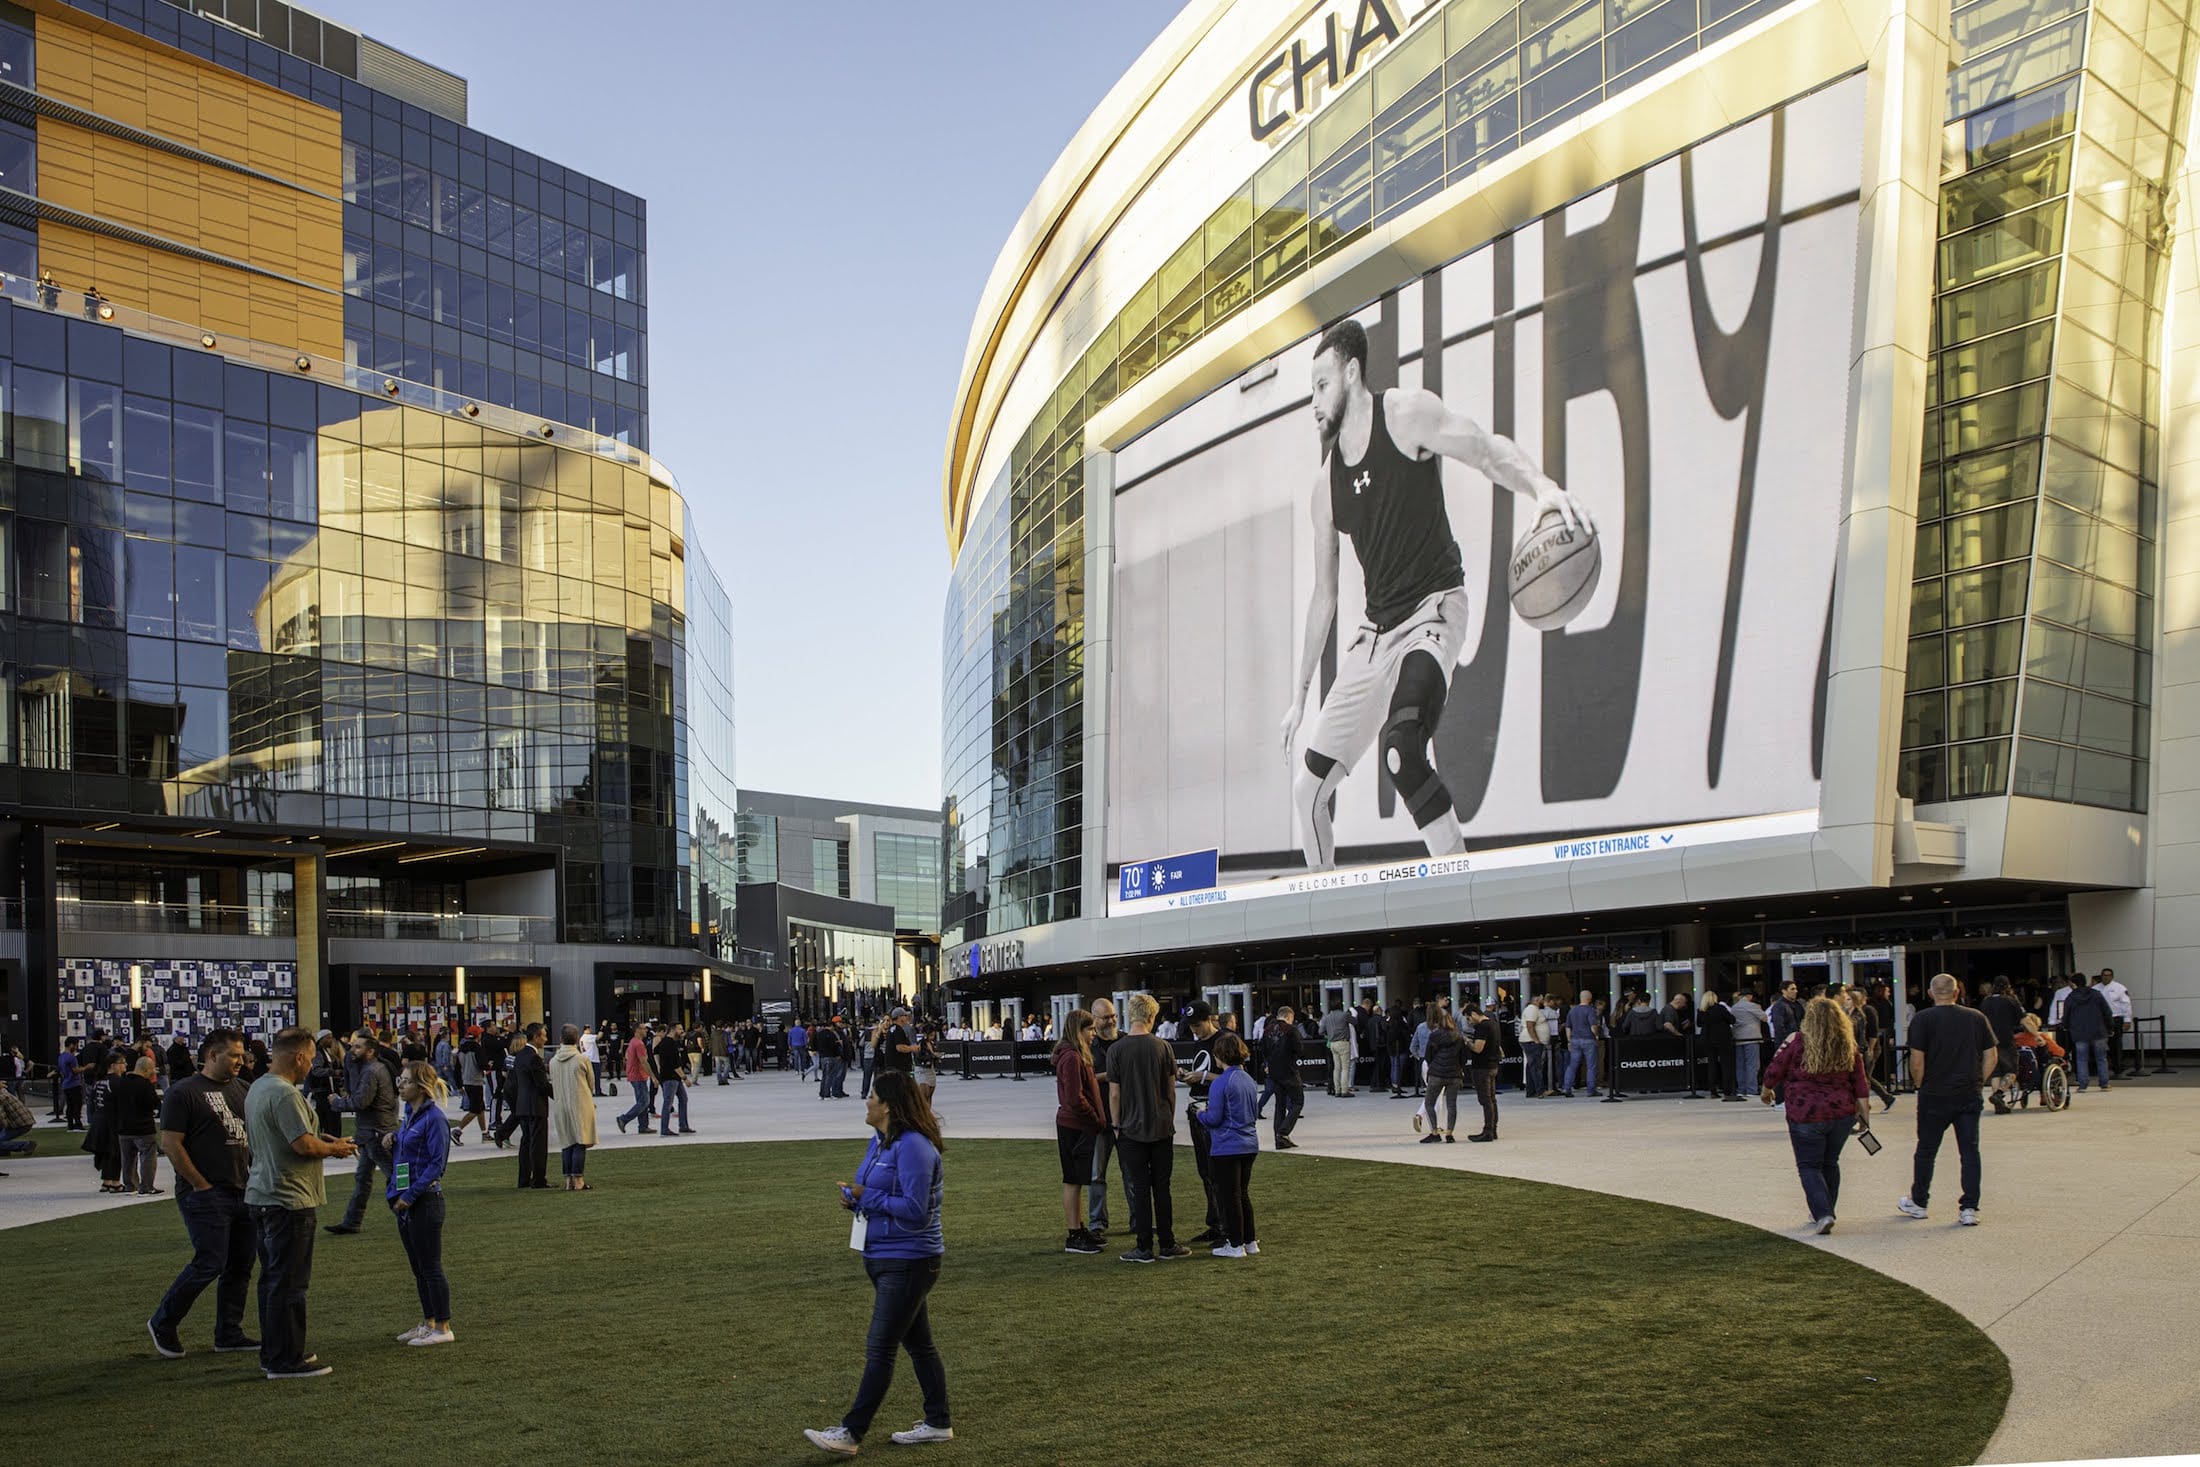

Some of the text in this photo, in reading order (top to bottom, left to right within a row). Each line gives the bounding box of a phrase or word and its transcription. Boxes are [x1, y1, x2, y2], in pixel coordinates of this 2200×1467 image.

[1249, 0, 1441, 141] CHA
[1554, 835, 1649, 858] VIP WEST ENTRANCE
[1170, 870, 1183, 880] FAIR
[1288, 859, 1471, 892] WELCOME TO CHASE CENTER
[1180, 890, 1227, 906] ALL OTHER PORTALS
[981, 941, 1020, 974] CENTER
[1620, 1059, 1684, 1069] CHASE CENTER
